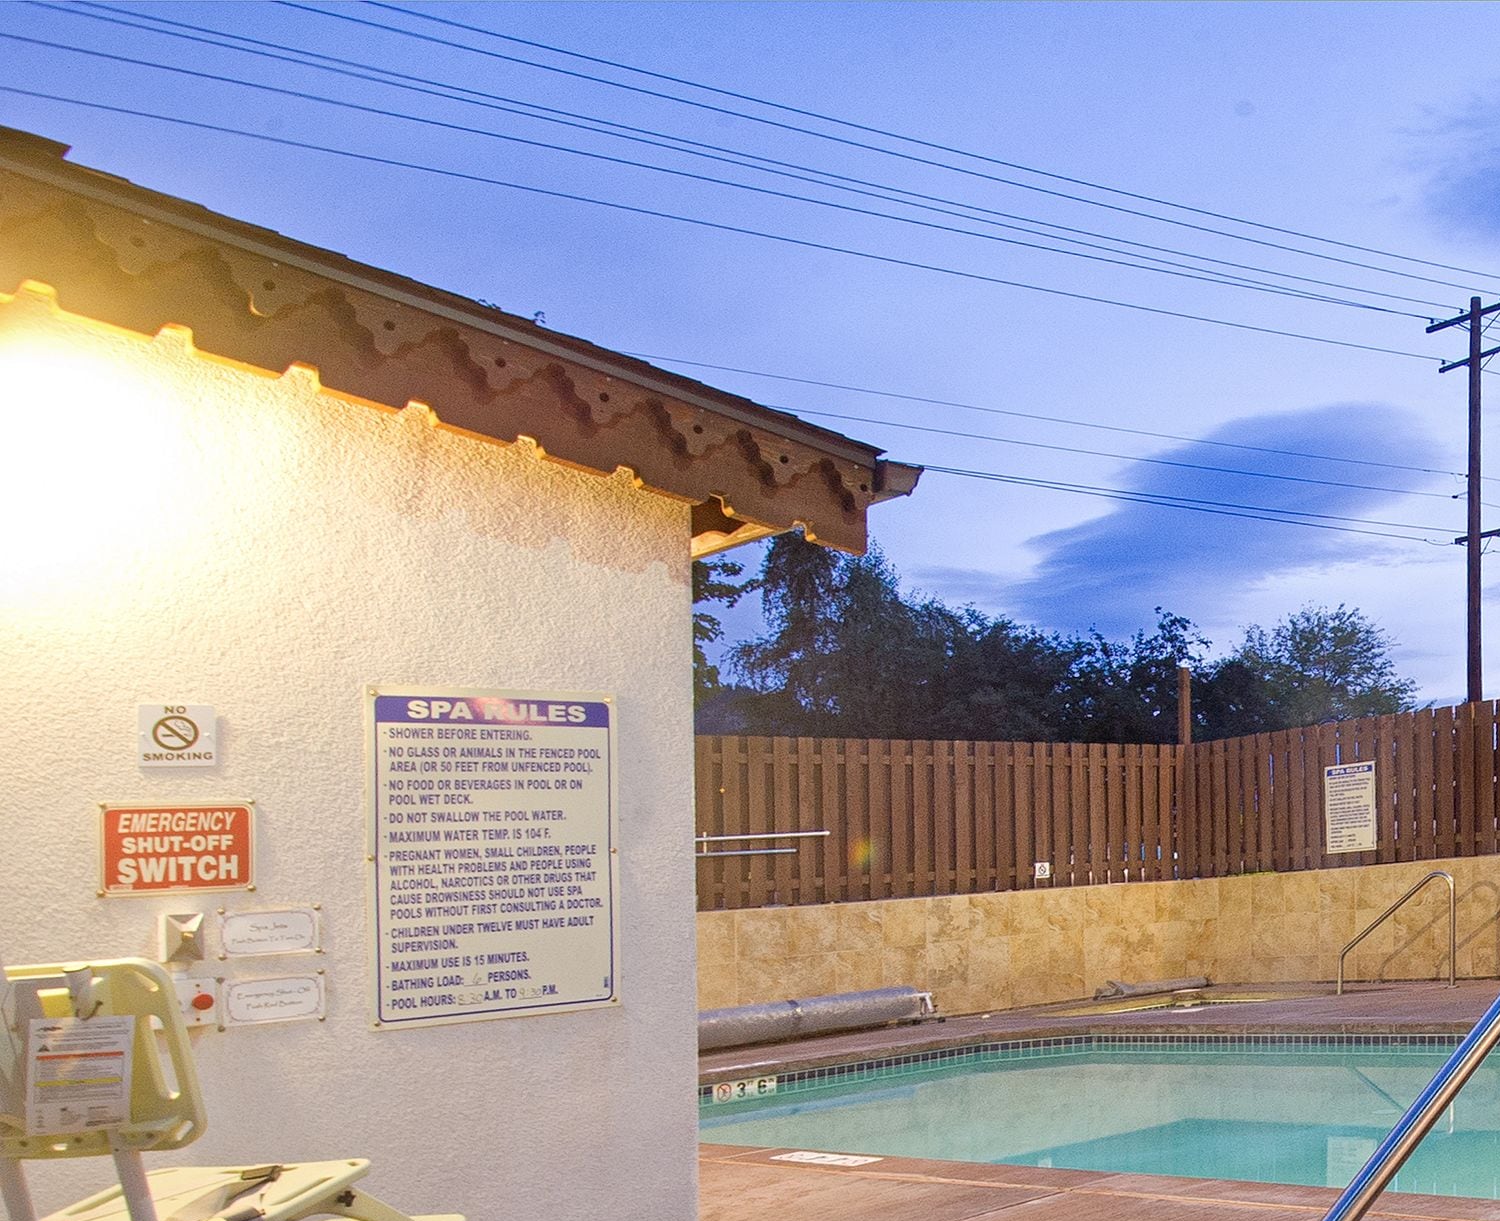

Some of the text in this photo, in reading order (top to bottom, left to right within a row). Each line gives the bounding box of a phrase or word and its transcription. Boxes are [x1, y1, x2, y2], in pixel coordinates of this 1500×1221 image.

[165, 706, 186, 714] NO
[407, 701, 586, 723] SPA RULES
[389, 728, 532, 741] SHOWER BEFORE ENTERING.
[143, 752, 213, 761] SMOKING
[389, 748, 600, 759] NO GLASS OR ANIMALS IN THE FENCED POOL
[390, 762, 416, 772] AREA
[420, 762, 437, 772] (OR
[441, 762, 451, 772] 50
[456, 762, 479, 772] FEET
[483, 762, 508, 772] FROM
[512, 762, 560, 772] UNFENCED
[389, 780, 582, 790] NO FOOD OR BEVERAGES IN POOL OR ON
[389, 794, 473, 805] POOL WET DECK.
[118, 811, 236, 834] EMERGENCY
[390, 811, 566, 823] DO NOT SWALLOW THE POOL WATER.
[390, 831, 440, 842] MAXIMUM
[444, 830, 479, 841] WATER
[482, 830, 509, 840] TEMP.
[513, 829, 522, 840] IS
[122, 835, 233, 854] SHUT-OFF
[390, 845, 596, 861] PREGNANT WOMEN, SMALL CHILDREN, PEOPLE
[118, 855, 238, 884] SWITCH
[390, 858, 591, 876] WITH HEALTH PROBLEMS AND PEOPLE USING
[391, 872, 596, 890] ALCOHOL, NARCOTICS OR OTHER DRUGS THAT
[390, 886, 582, 905] CAUSE DROWSINESS SHOULD NOT USE SPA
[390, 898, 603, 920] POOLS WITHOUT FIRST CONSULTING A DOCTOR.
[392, 916, 594, 938] CHILDREN UNDER TWELVE MUST HAVE ADULT
[392, 940, 458, 953] SUPERVISION.
[392, 952, 530, 972] MAXIMUM USE IS 15 MINUTES.
[392, 977, 434, 991] BATHING
[437, 975, 464, 986] LOAD:
[488, 970, 531, 982] PERSONS.
[392, 997, 417, 1010] POOL
[421, 994, 456, 1007] HOURS:
[484, 990, 502, 1001] A.M.
[506, 988, 517, 999] TO
[543, 985, 558, 995] P.M.
[737, 1082, 746, 1097] 3
